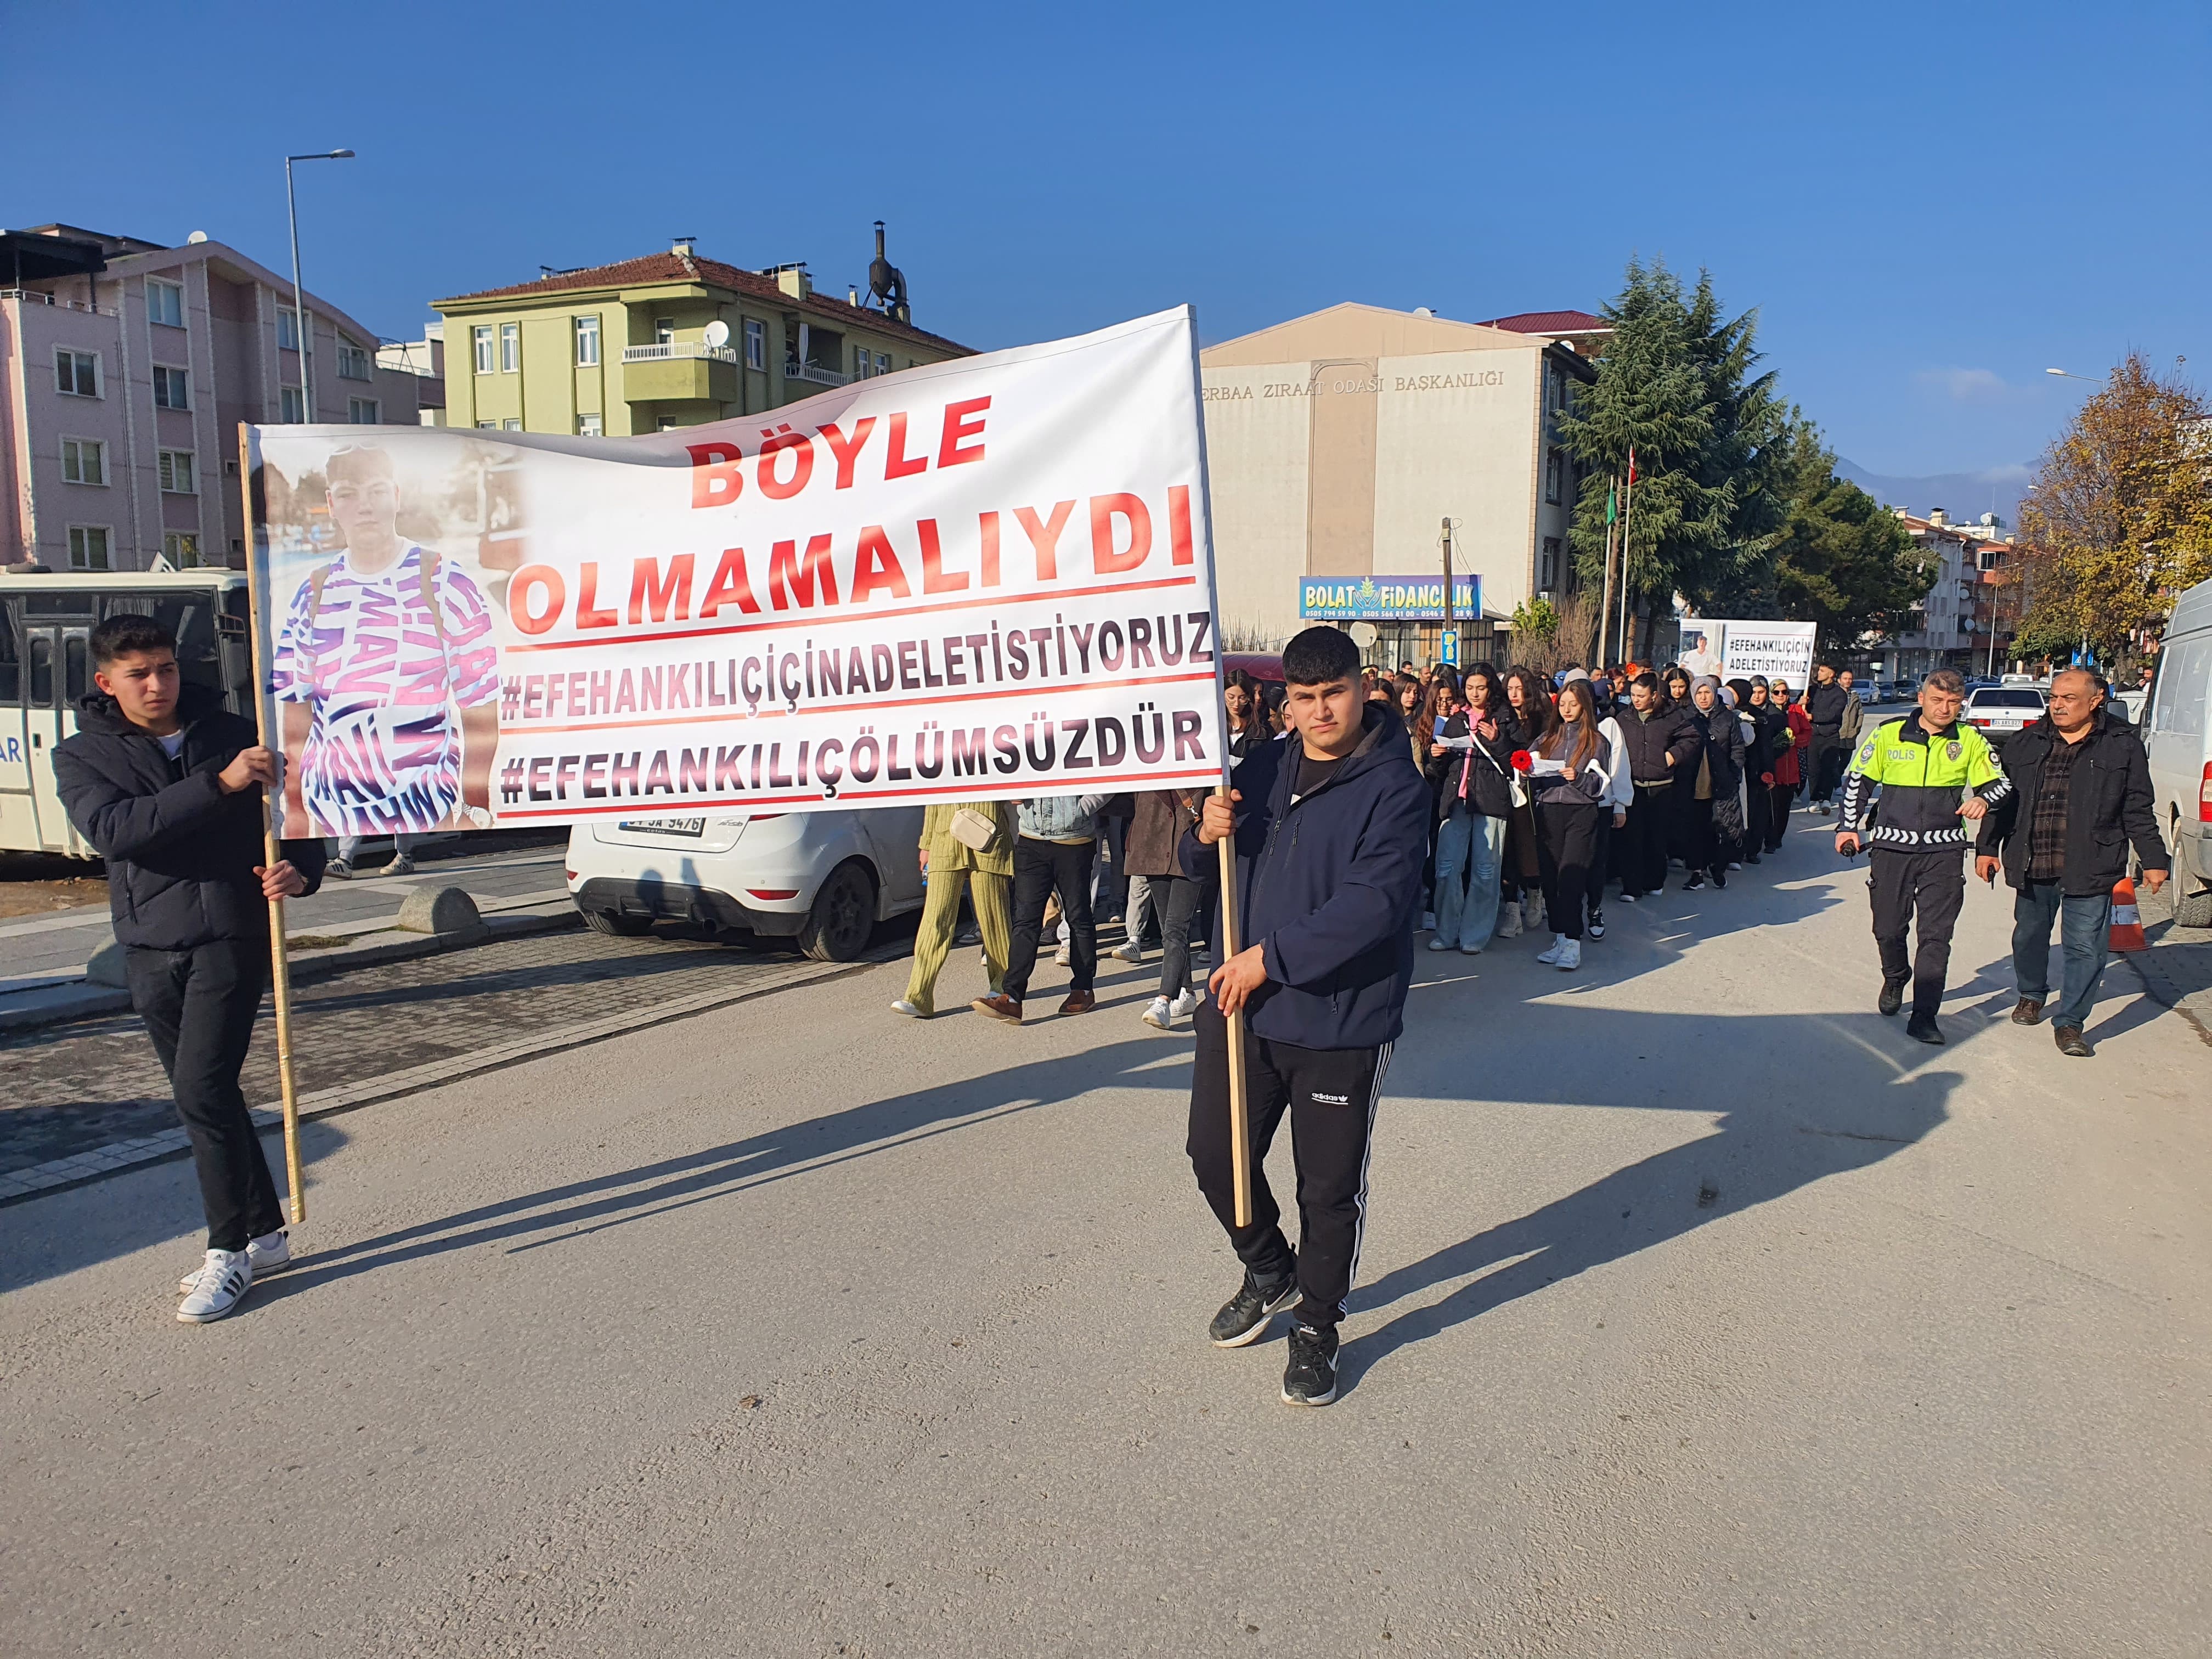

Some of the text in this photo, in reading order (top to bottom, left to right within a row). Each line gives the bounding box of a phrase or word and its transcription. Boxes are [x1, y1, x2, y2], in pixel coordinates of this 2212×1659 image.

[1334, 378, 1385, 394] ODASI
[1395, 370, 1504, 391] BAŞKANLIĞI
[685, 395, 992, 509] BÖYLE
[509, 484, 1194, 634] OLMAMALIYDI
[1306, 585, 1355, 608] BOLAT
[1730, 638, 1810, 656] #EFEHANKILIÇİÇİN
[501, 611, 1215, 721] #EFEHANKILIÇİÇİNADELETİSTİYORUZ
[1729, 656, 1808, 673] ADELETİSTİYORUZ
[501, 702, 1206, 805] #EFEHANKILIÇÖLÜMSÜZDÜR
[1312, 1092, 1338, 1102] adidas
